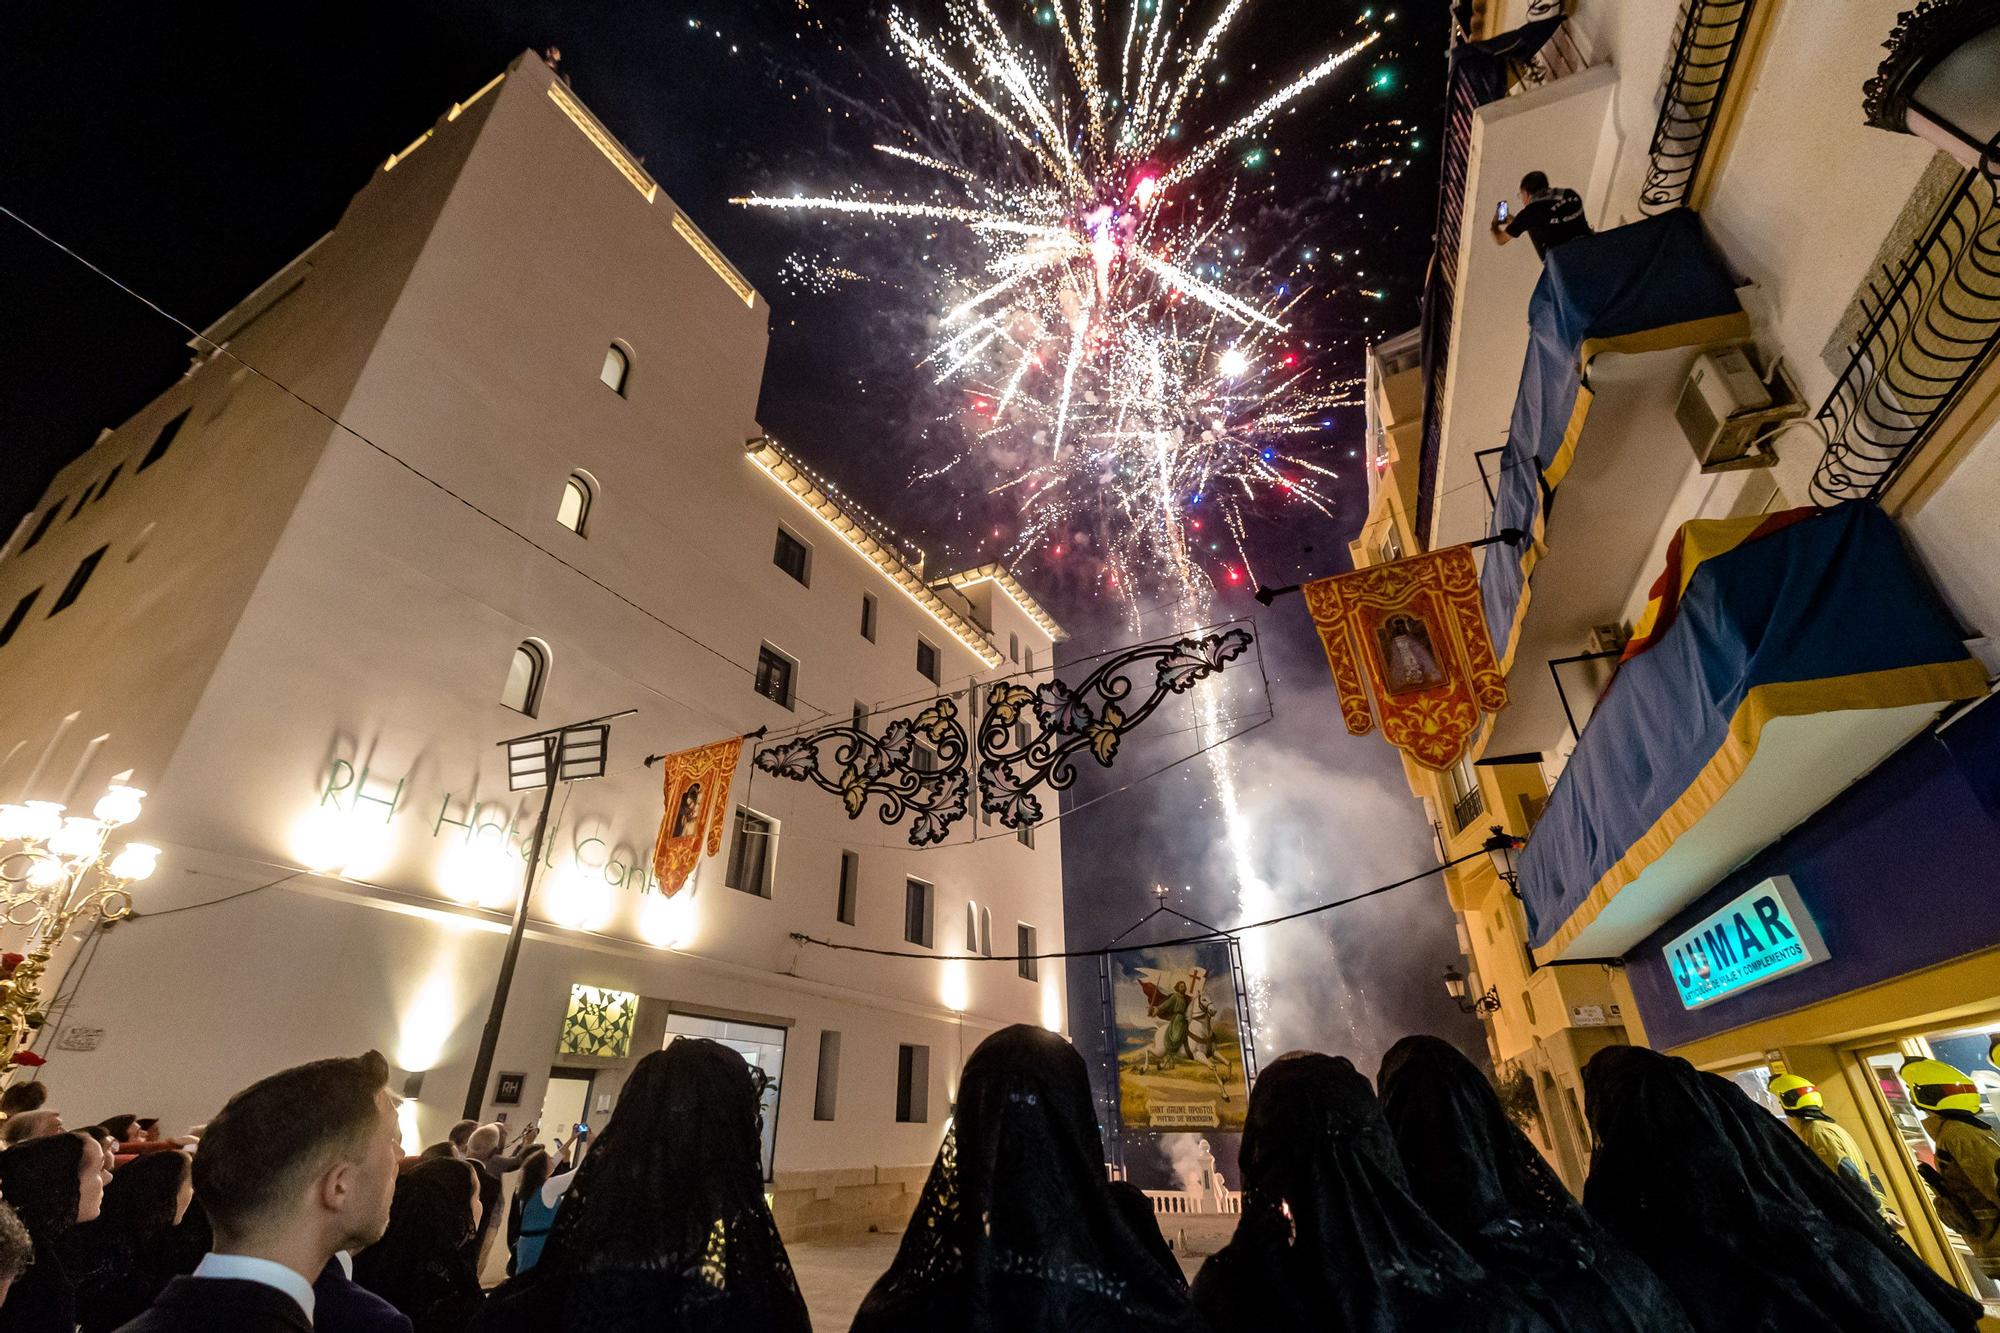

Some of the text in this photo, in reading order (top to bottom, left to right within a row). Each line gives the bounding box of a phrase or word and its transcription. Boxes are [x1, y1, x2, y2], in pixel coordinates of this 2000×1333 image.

[320, 758, 405, 824] RH
[433, 791, 557, 869] Hotel
[1675, 896, 1795, 988] JUMAR
[1720, 971, 1738, 986] VIAJE
[1744, 943, 1803, 976] COMPLEMENTOS
[502, 1081, 519, 1093] RH
